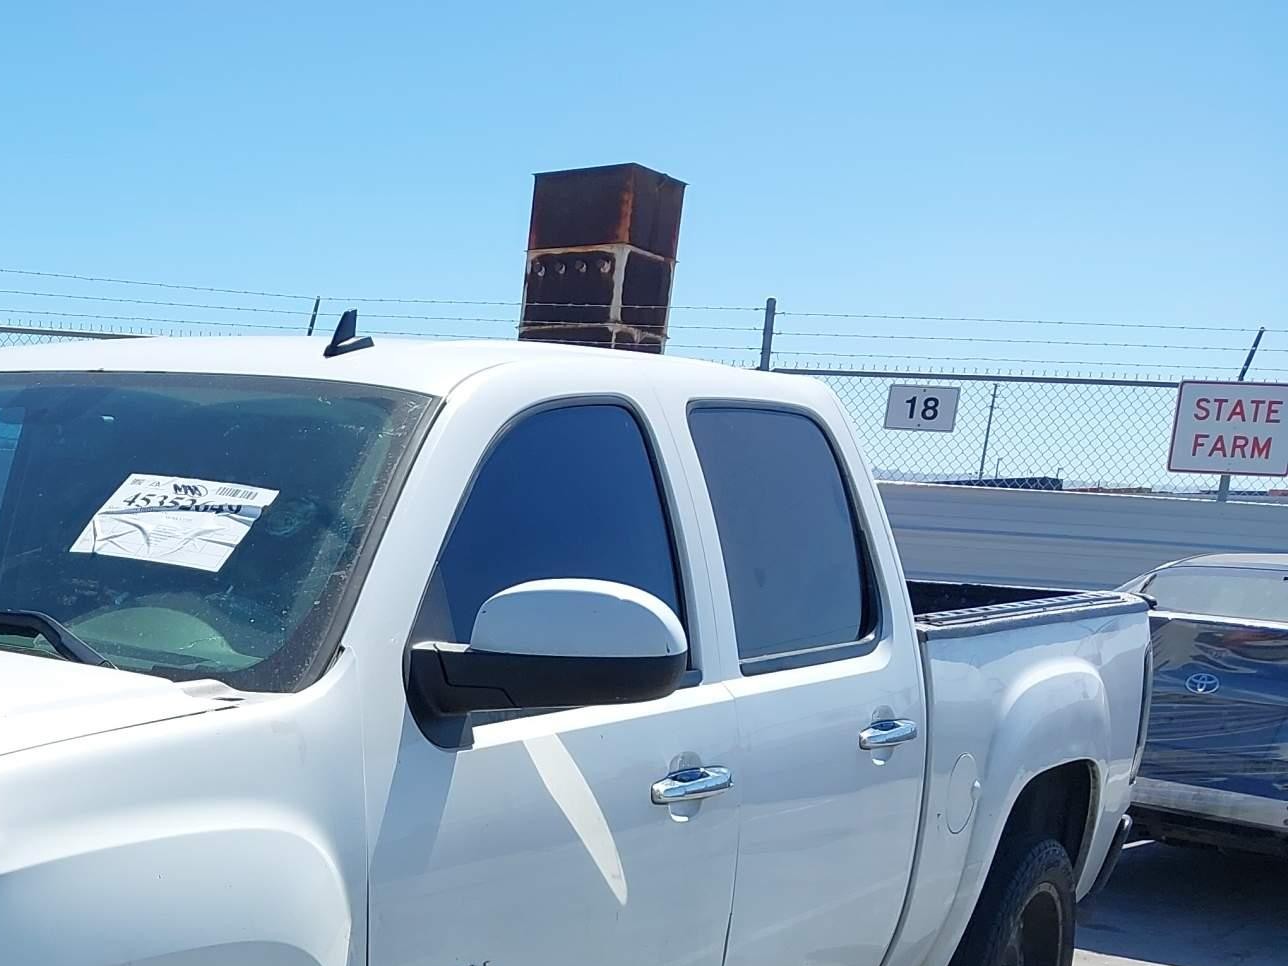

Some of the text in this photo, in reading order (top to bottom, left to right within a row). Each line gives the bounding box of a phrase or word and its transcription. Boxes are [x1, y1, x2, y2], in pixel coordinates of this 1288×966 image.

[905, 396, 939, 420] 18
[1194, 398, 1283, 423] STATE
[1192, 434, 1272, 459] FARM
